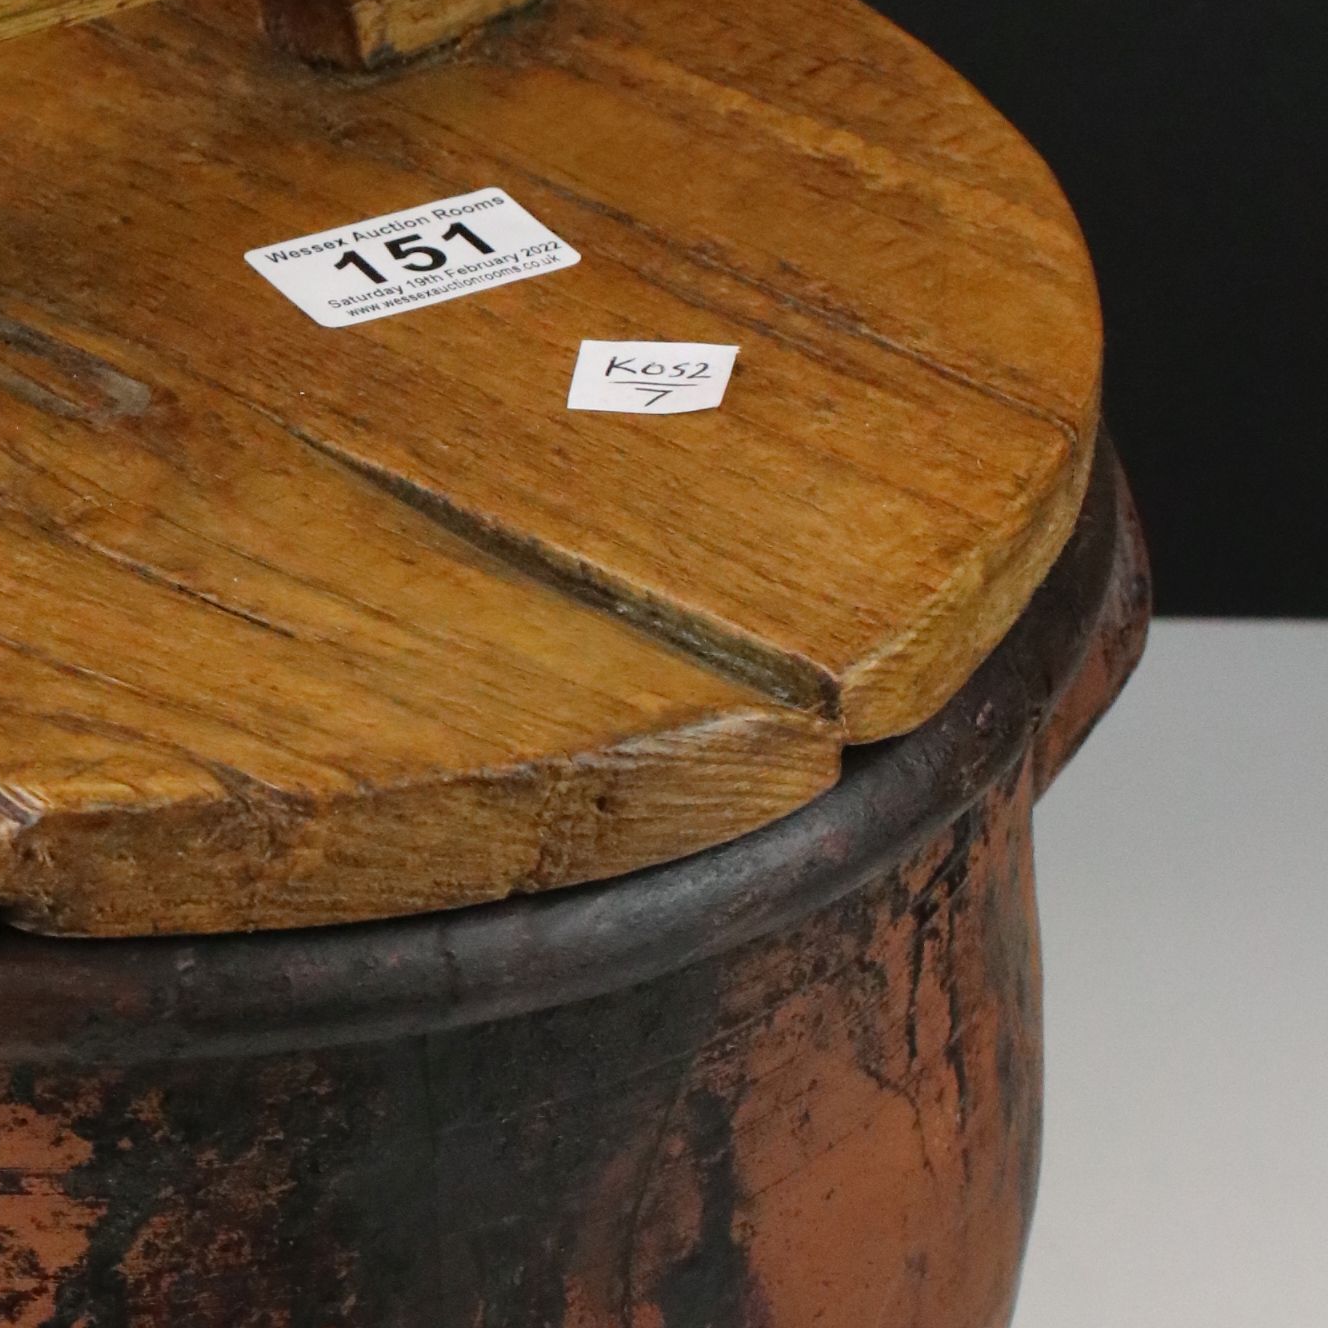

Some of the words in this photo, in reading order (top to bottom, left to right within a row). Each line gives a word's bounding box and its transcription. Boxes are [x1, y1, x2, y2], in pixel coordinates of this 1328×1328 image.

[266, 237, 345, 265] Wessex
[352, 215, 431, 243] Auction
[433, 195, 505, 222] Rooms
[333, 221, 497, 285] 151
[327, 283, 404, 310] Saturday
[405, 271, 443, 290] 19th
[444, 251, 520, 279] February
[523, 240, 562, 258] 2022
[346, 254, 561, 318] www.wessexauctionrooms.co.uk
[634, 387, 674, 407] 7
